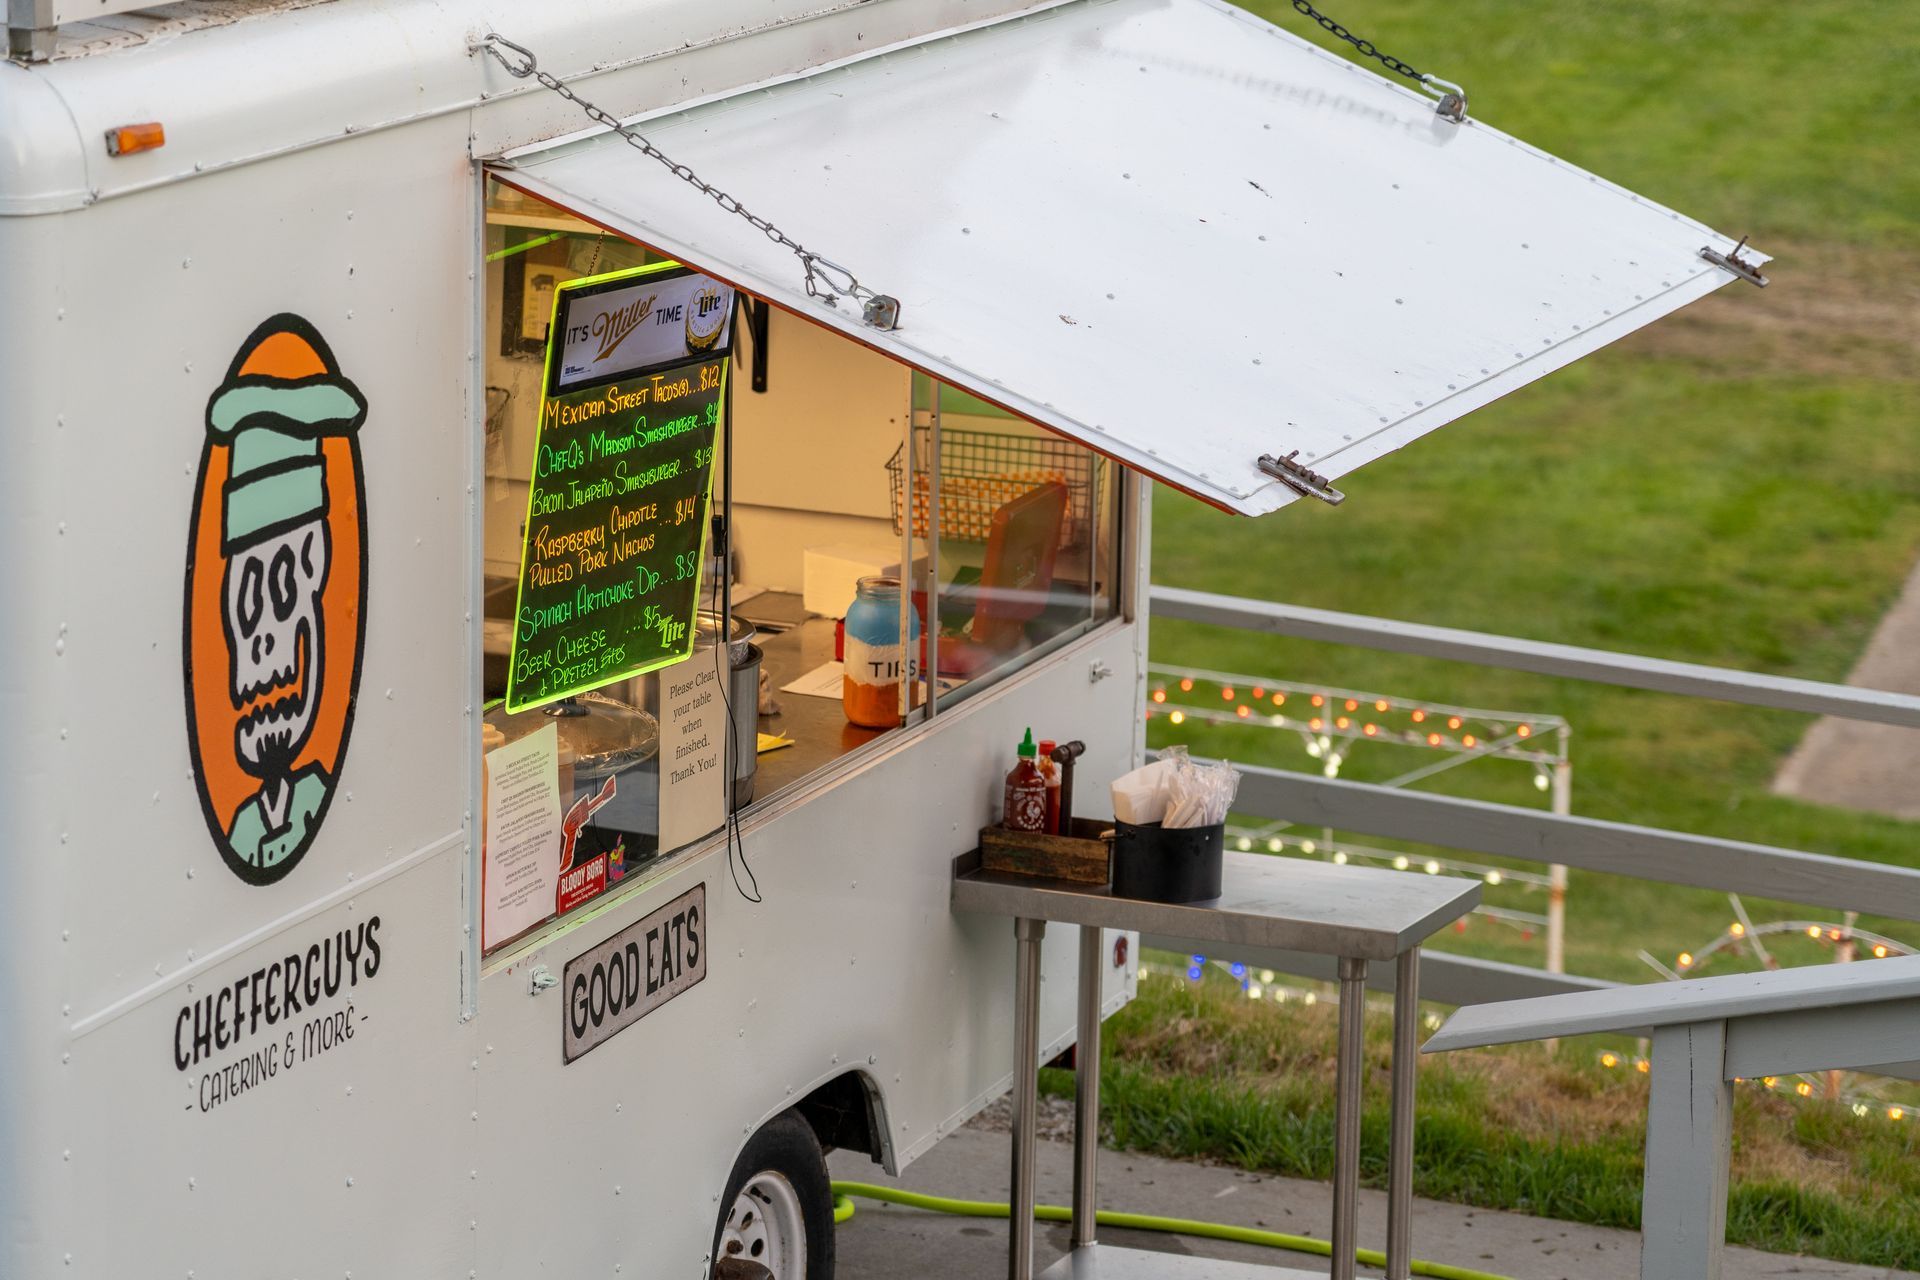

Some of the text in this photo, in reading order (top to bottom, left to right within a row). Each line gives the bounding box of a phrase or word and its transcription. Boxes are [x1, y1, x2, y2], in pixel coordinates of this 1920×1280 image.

[567, 325, 589, 345] IT'S
[592, 293, 658, 361] Miller
[656, 304, 682, 325] TIME
[697, 294, 721, 318] Lite
[608, 387, 649, 414] STREET
[700, 365, 720, 392] $12
[590, 430, 635, 462] MADISON
[532, 488, 564, 517] BACON
[694, 446, 712, 469] $13
[535, 524, 604, 561] RASPBERRY
[610, 502, 657, 535] CHIPOTLE
[675, 495, 697, 526] $14
[529, 532, 654, 590] PULLED PORK NACHOS
[519, 600, 572, 642] SPINACH
[577, 581, 635, 618] ARTICHOKE
[675, 550, 696, 580] $8
[516, 649, 551, 685] BEER
[557, 629, 607, 665] CHEESE
[643, 604, 661, 630] $5
[660, 619, 686, 648] Lite
[550, 659, 599, 690] PRETZEL
[670, 668, 716, 699] Please Clear
[673, 691, 712, 723] your table
[681, 716, 702, 736] when
[675, 733, 710, 760] finished.
[670, 753, 717, 785] Thank You!
[561, 866, 585, 896] BLOODY
[586, 857, 604, 882] BORG
[174, 915, 381, 1072] CHEFFERGUYS
[570, 905, 699, 1039] GOOD EATS
[199, 1042, 278, 1113] CATERING
[283, 1031, 295, 1070] &
[302, 1005, 355, 1062] MORE
